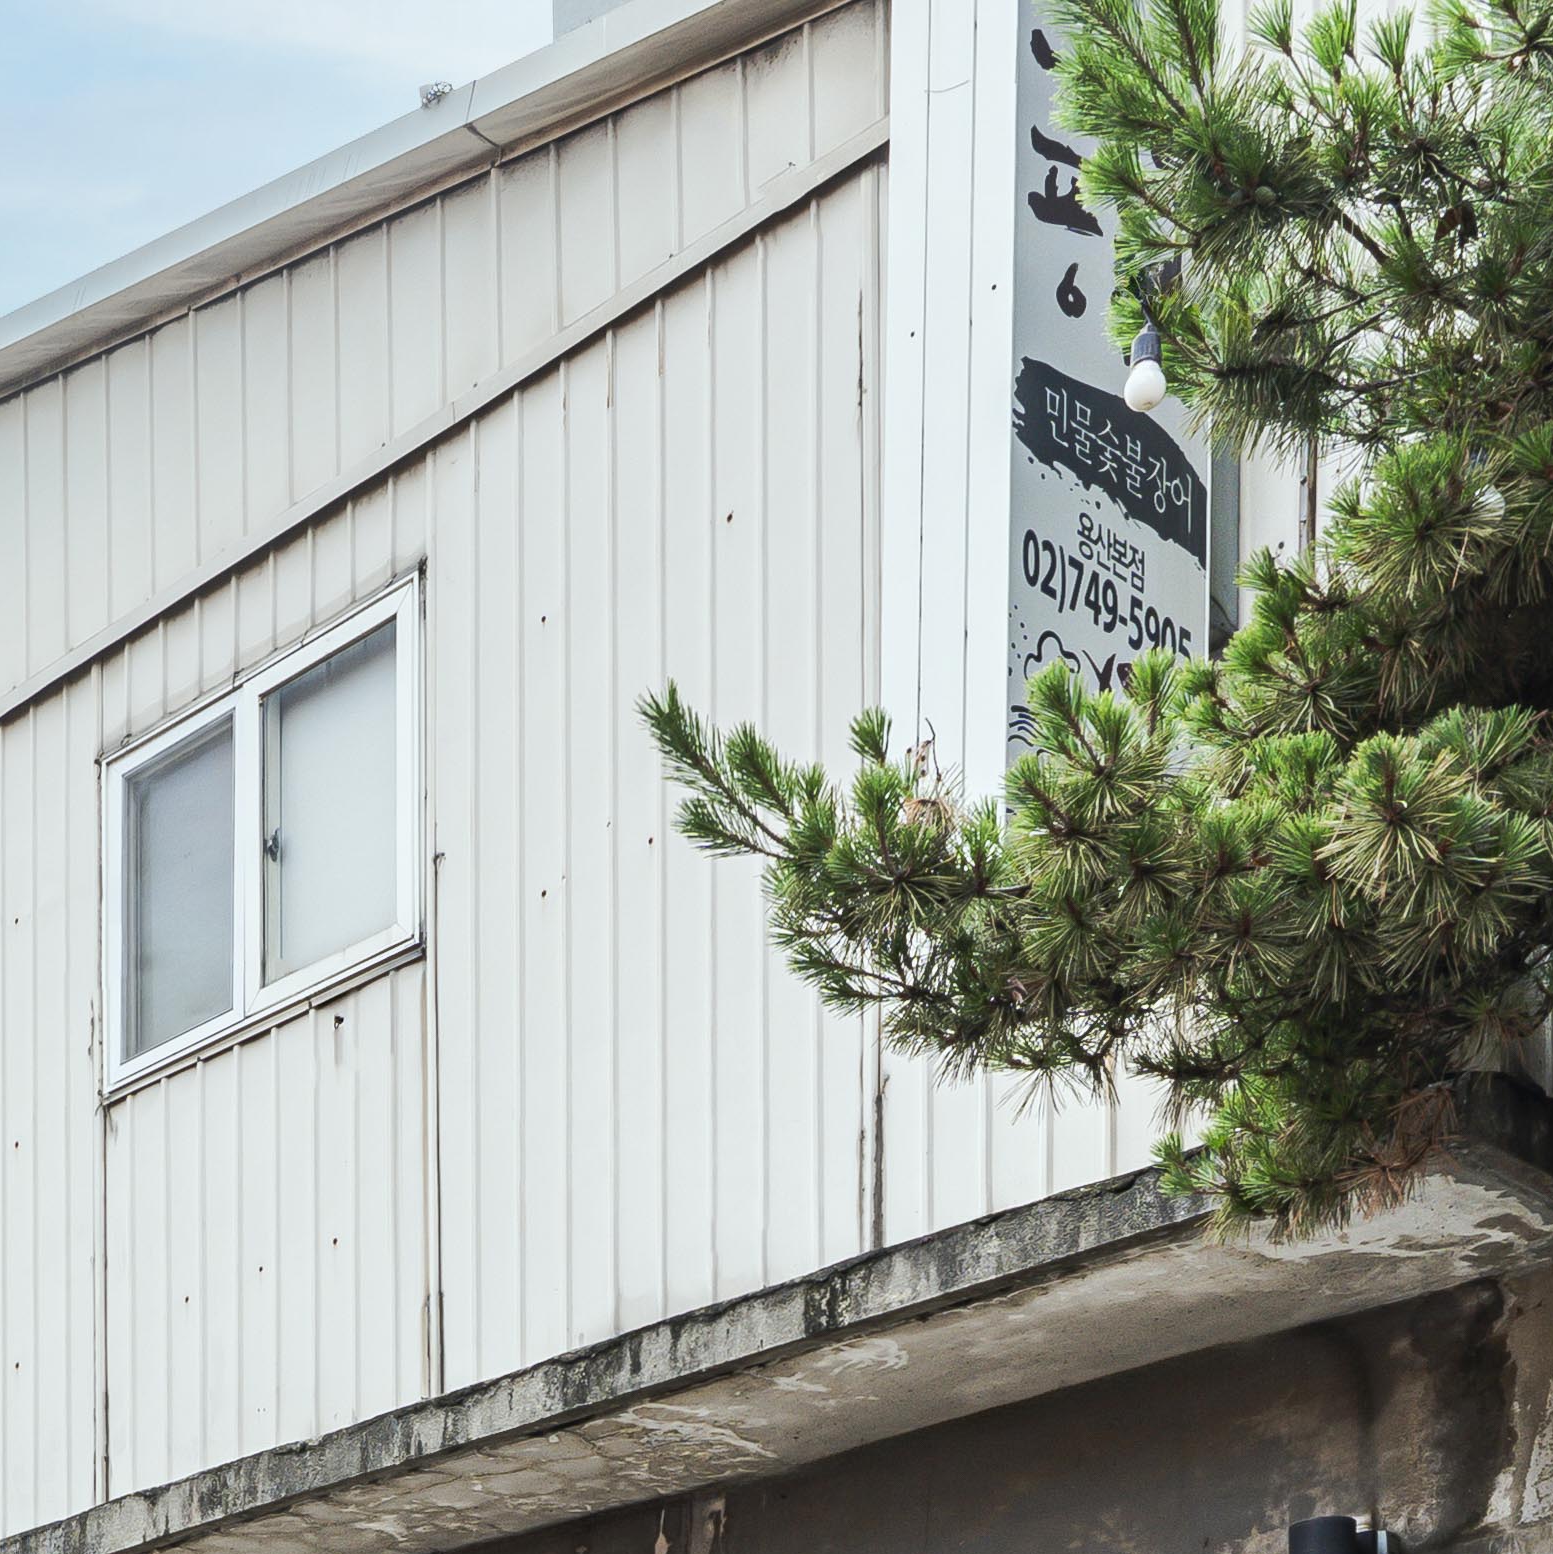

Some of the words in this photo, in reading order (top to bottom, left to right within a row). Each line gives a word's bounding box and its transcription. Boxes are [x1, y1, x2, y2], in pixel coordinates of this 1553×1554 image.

[1045, 386, 1193, 533] 민물숯불장어
[1022, 528, 1192, 661] 02)749-5905
[1077, 511, 1146, 594] 용산본점
